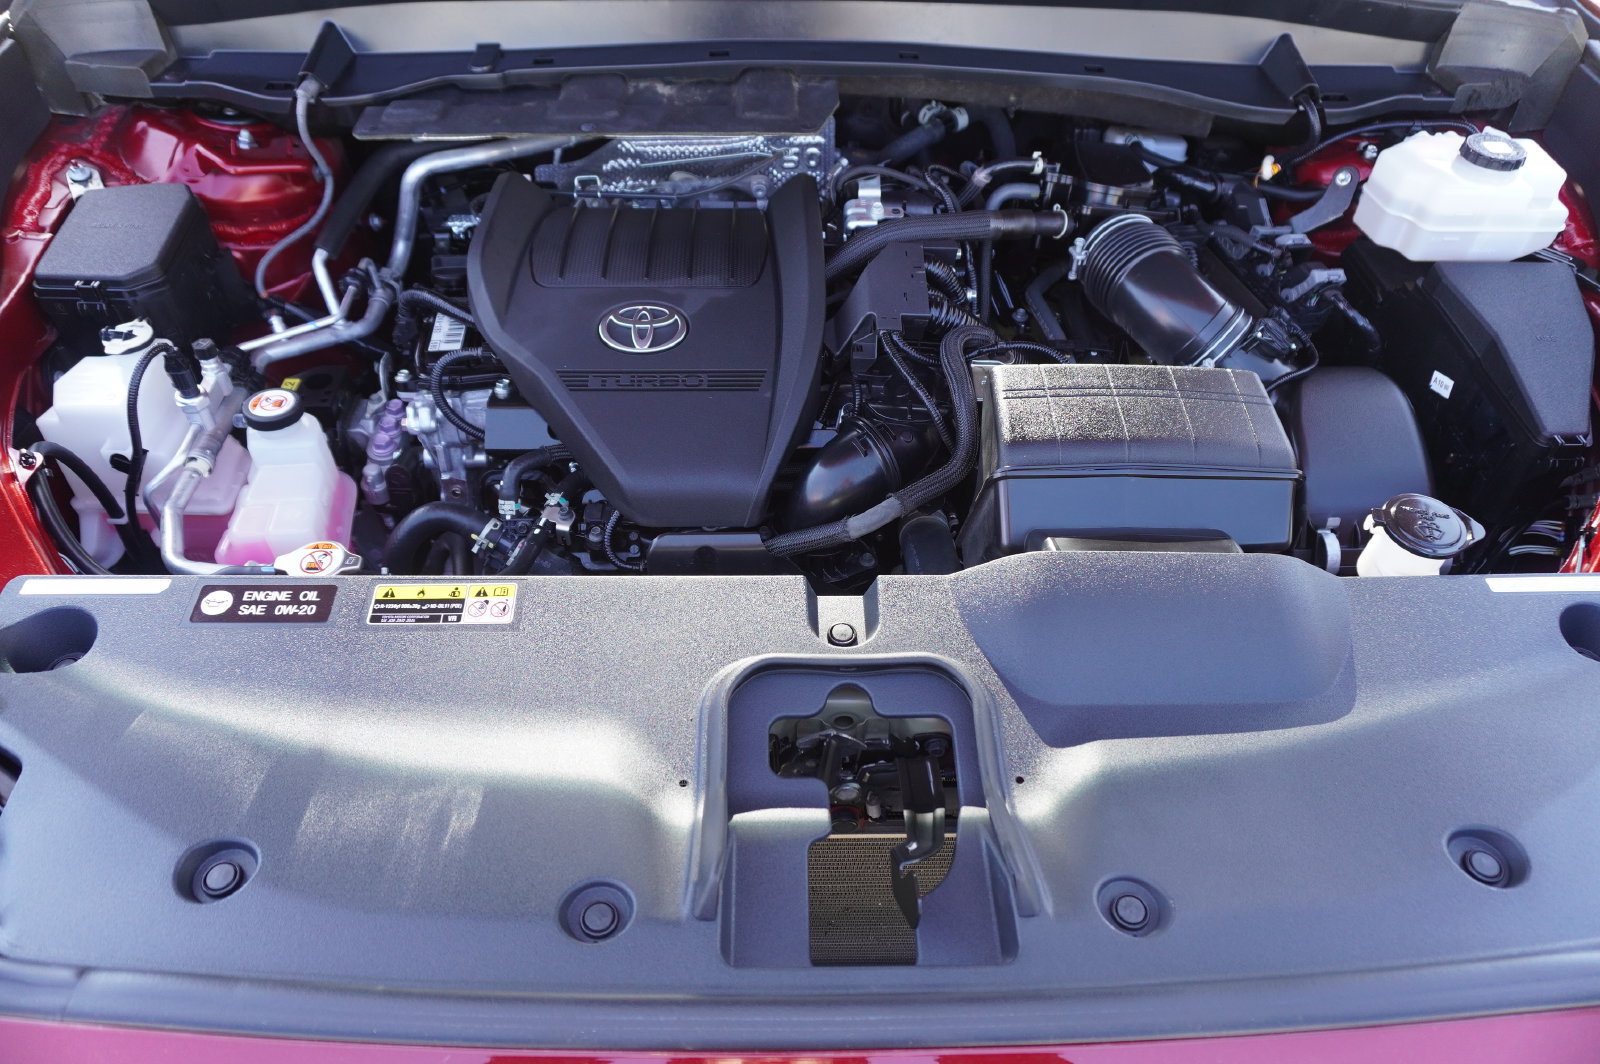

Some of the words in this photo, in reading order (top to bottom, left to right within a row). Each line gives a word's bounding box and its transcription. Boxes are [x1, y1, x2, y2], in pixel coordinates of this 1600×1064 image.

[592, 374, 705, 389] TURBO
[242, 590, 293, 601] ENGINE
[299, 590, 320, 601] OIL
[238, 604, 267, 615] SAE
[274, 604, 316, 615] 0W-20
